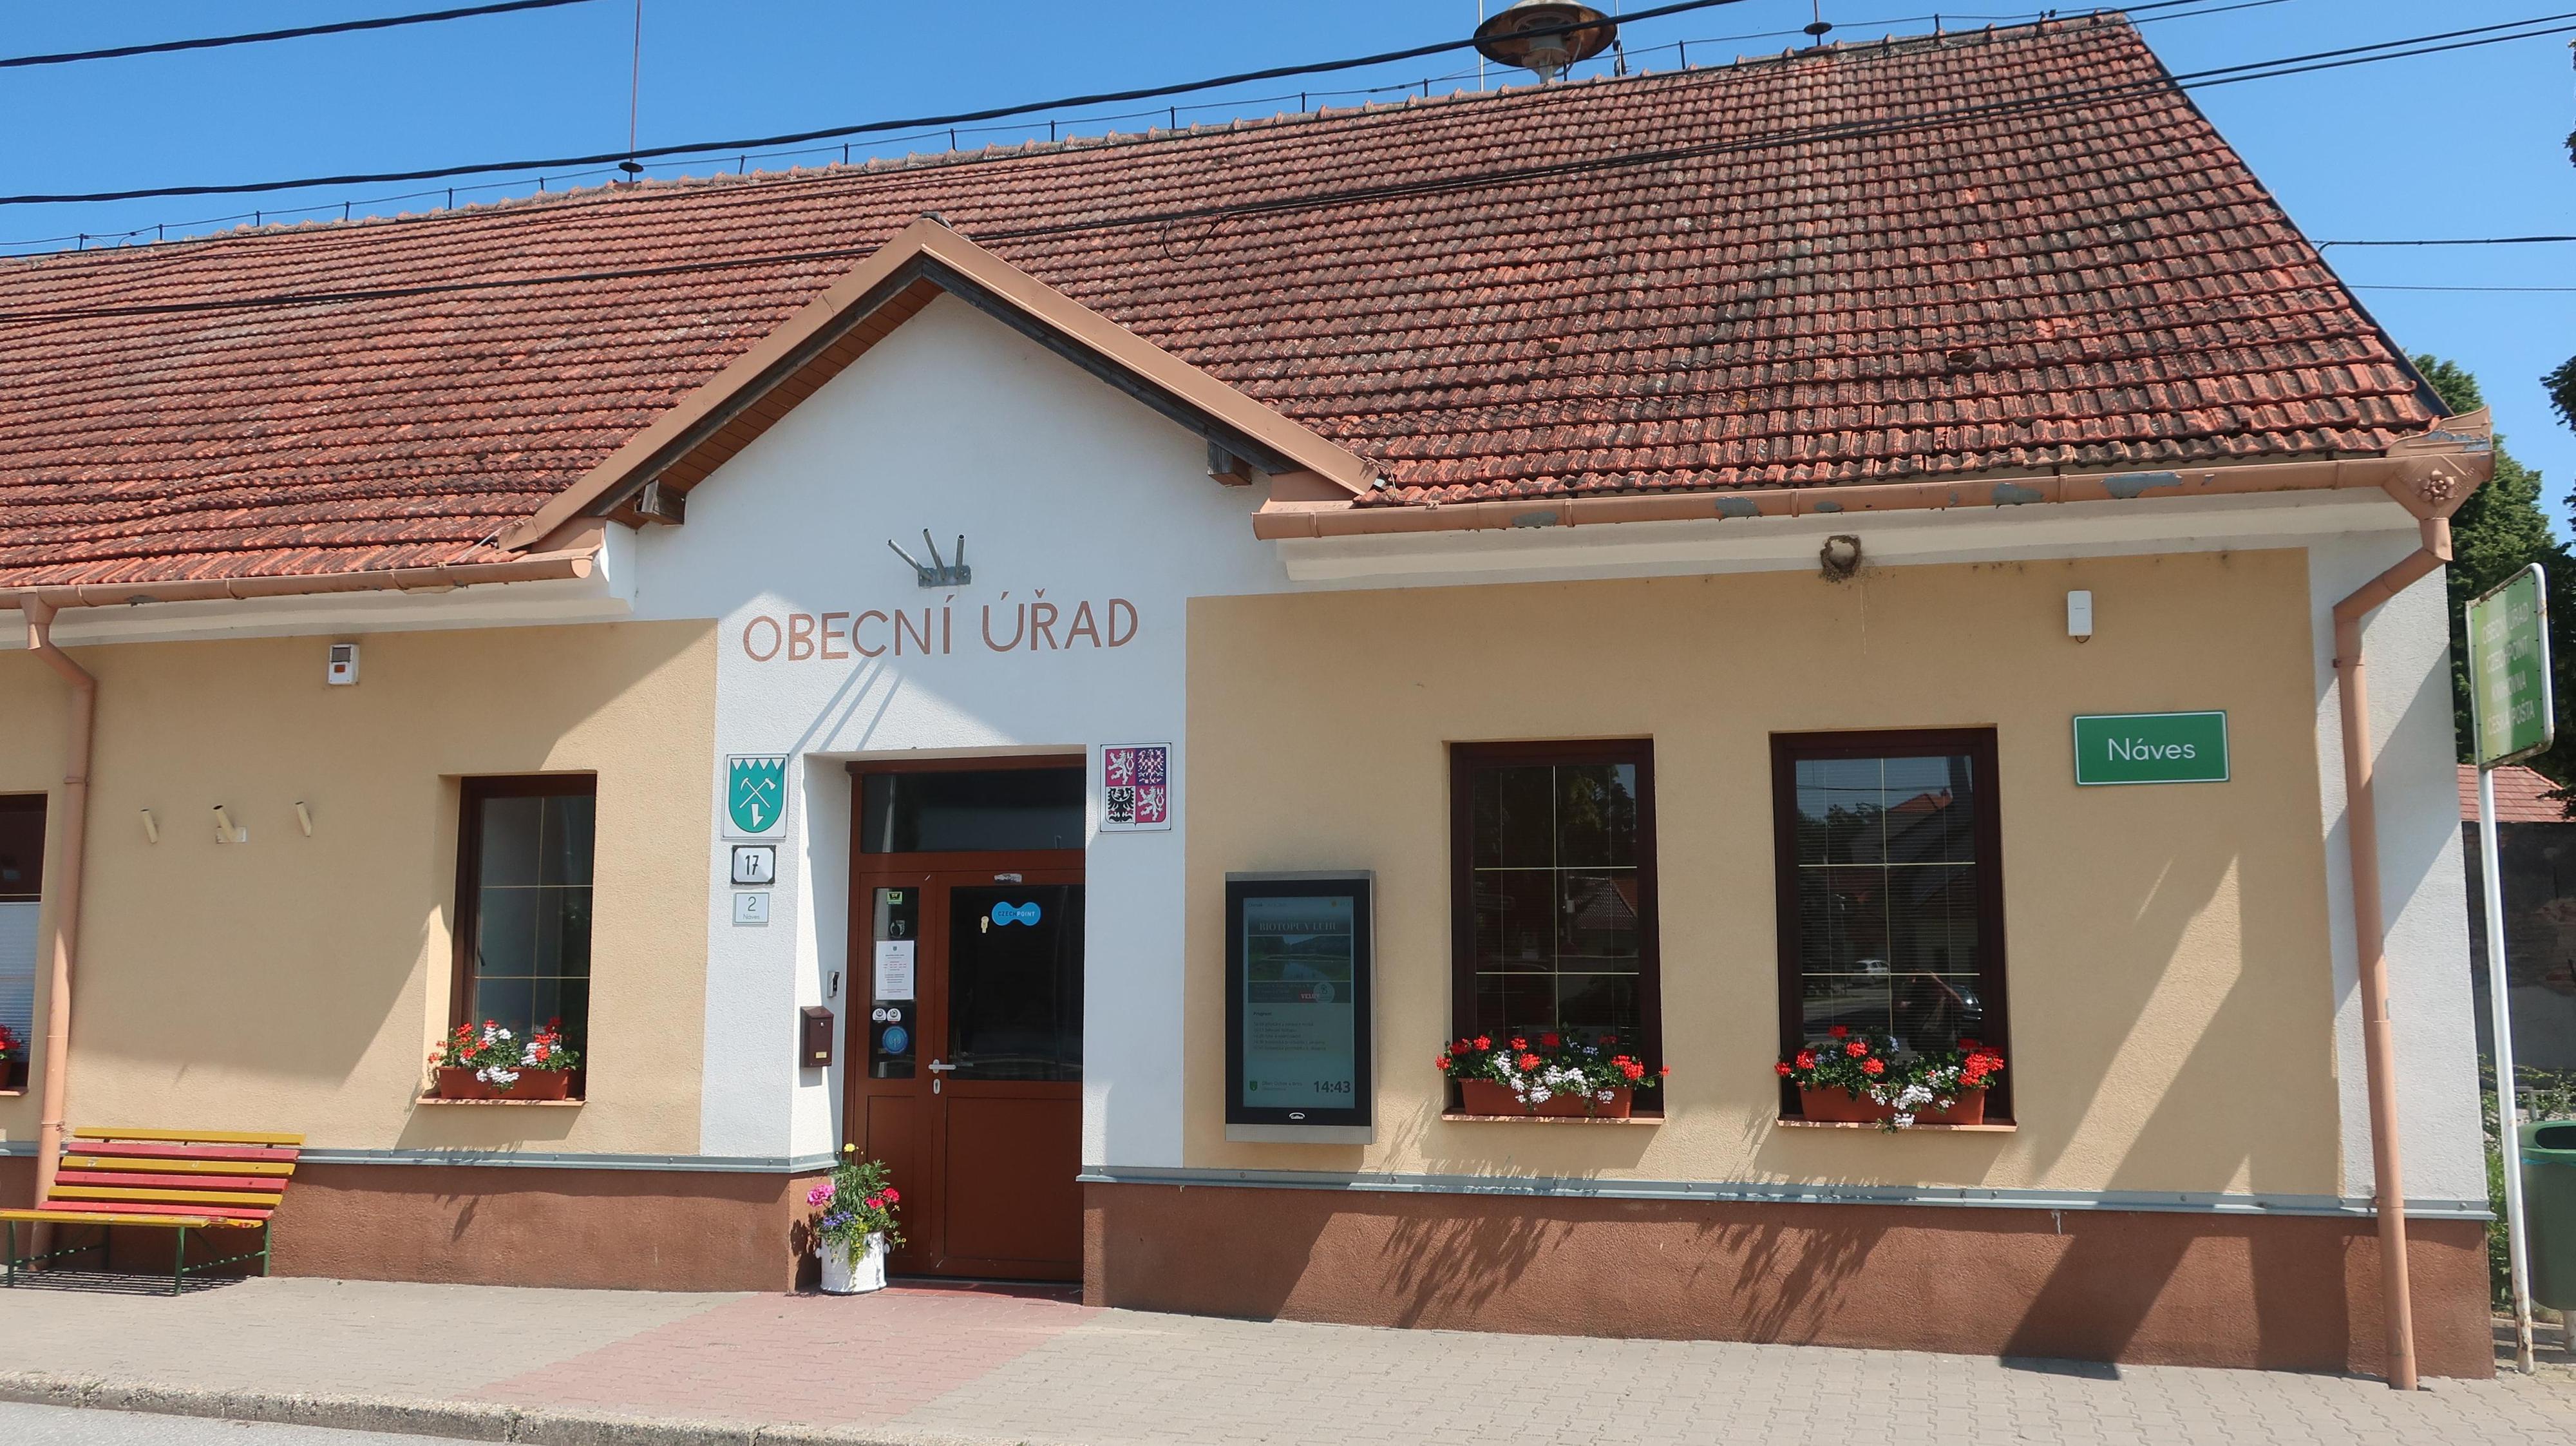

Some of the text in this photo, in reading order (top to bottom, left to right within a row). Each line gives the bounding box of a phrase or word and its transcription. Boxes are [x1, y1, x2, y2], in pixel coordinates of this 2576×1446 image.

[743, 588, 1139, 662] OBECNÍ ÚŘAD
[2108, 737, 2196, 761] Náves
[745, 855, 759, 875] 17
[747, 896, 756, 911] 2
[1314, 1081, 1350, 1093] 14:43
